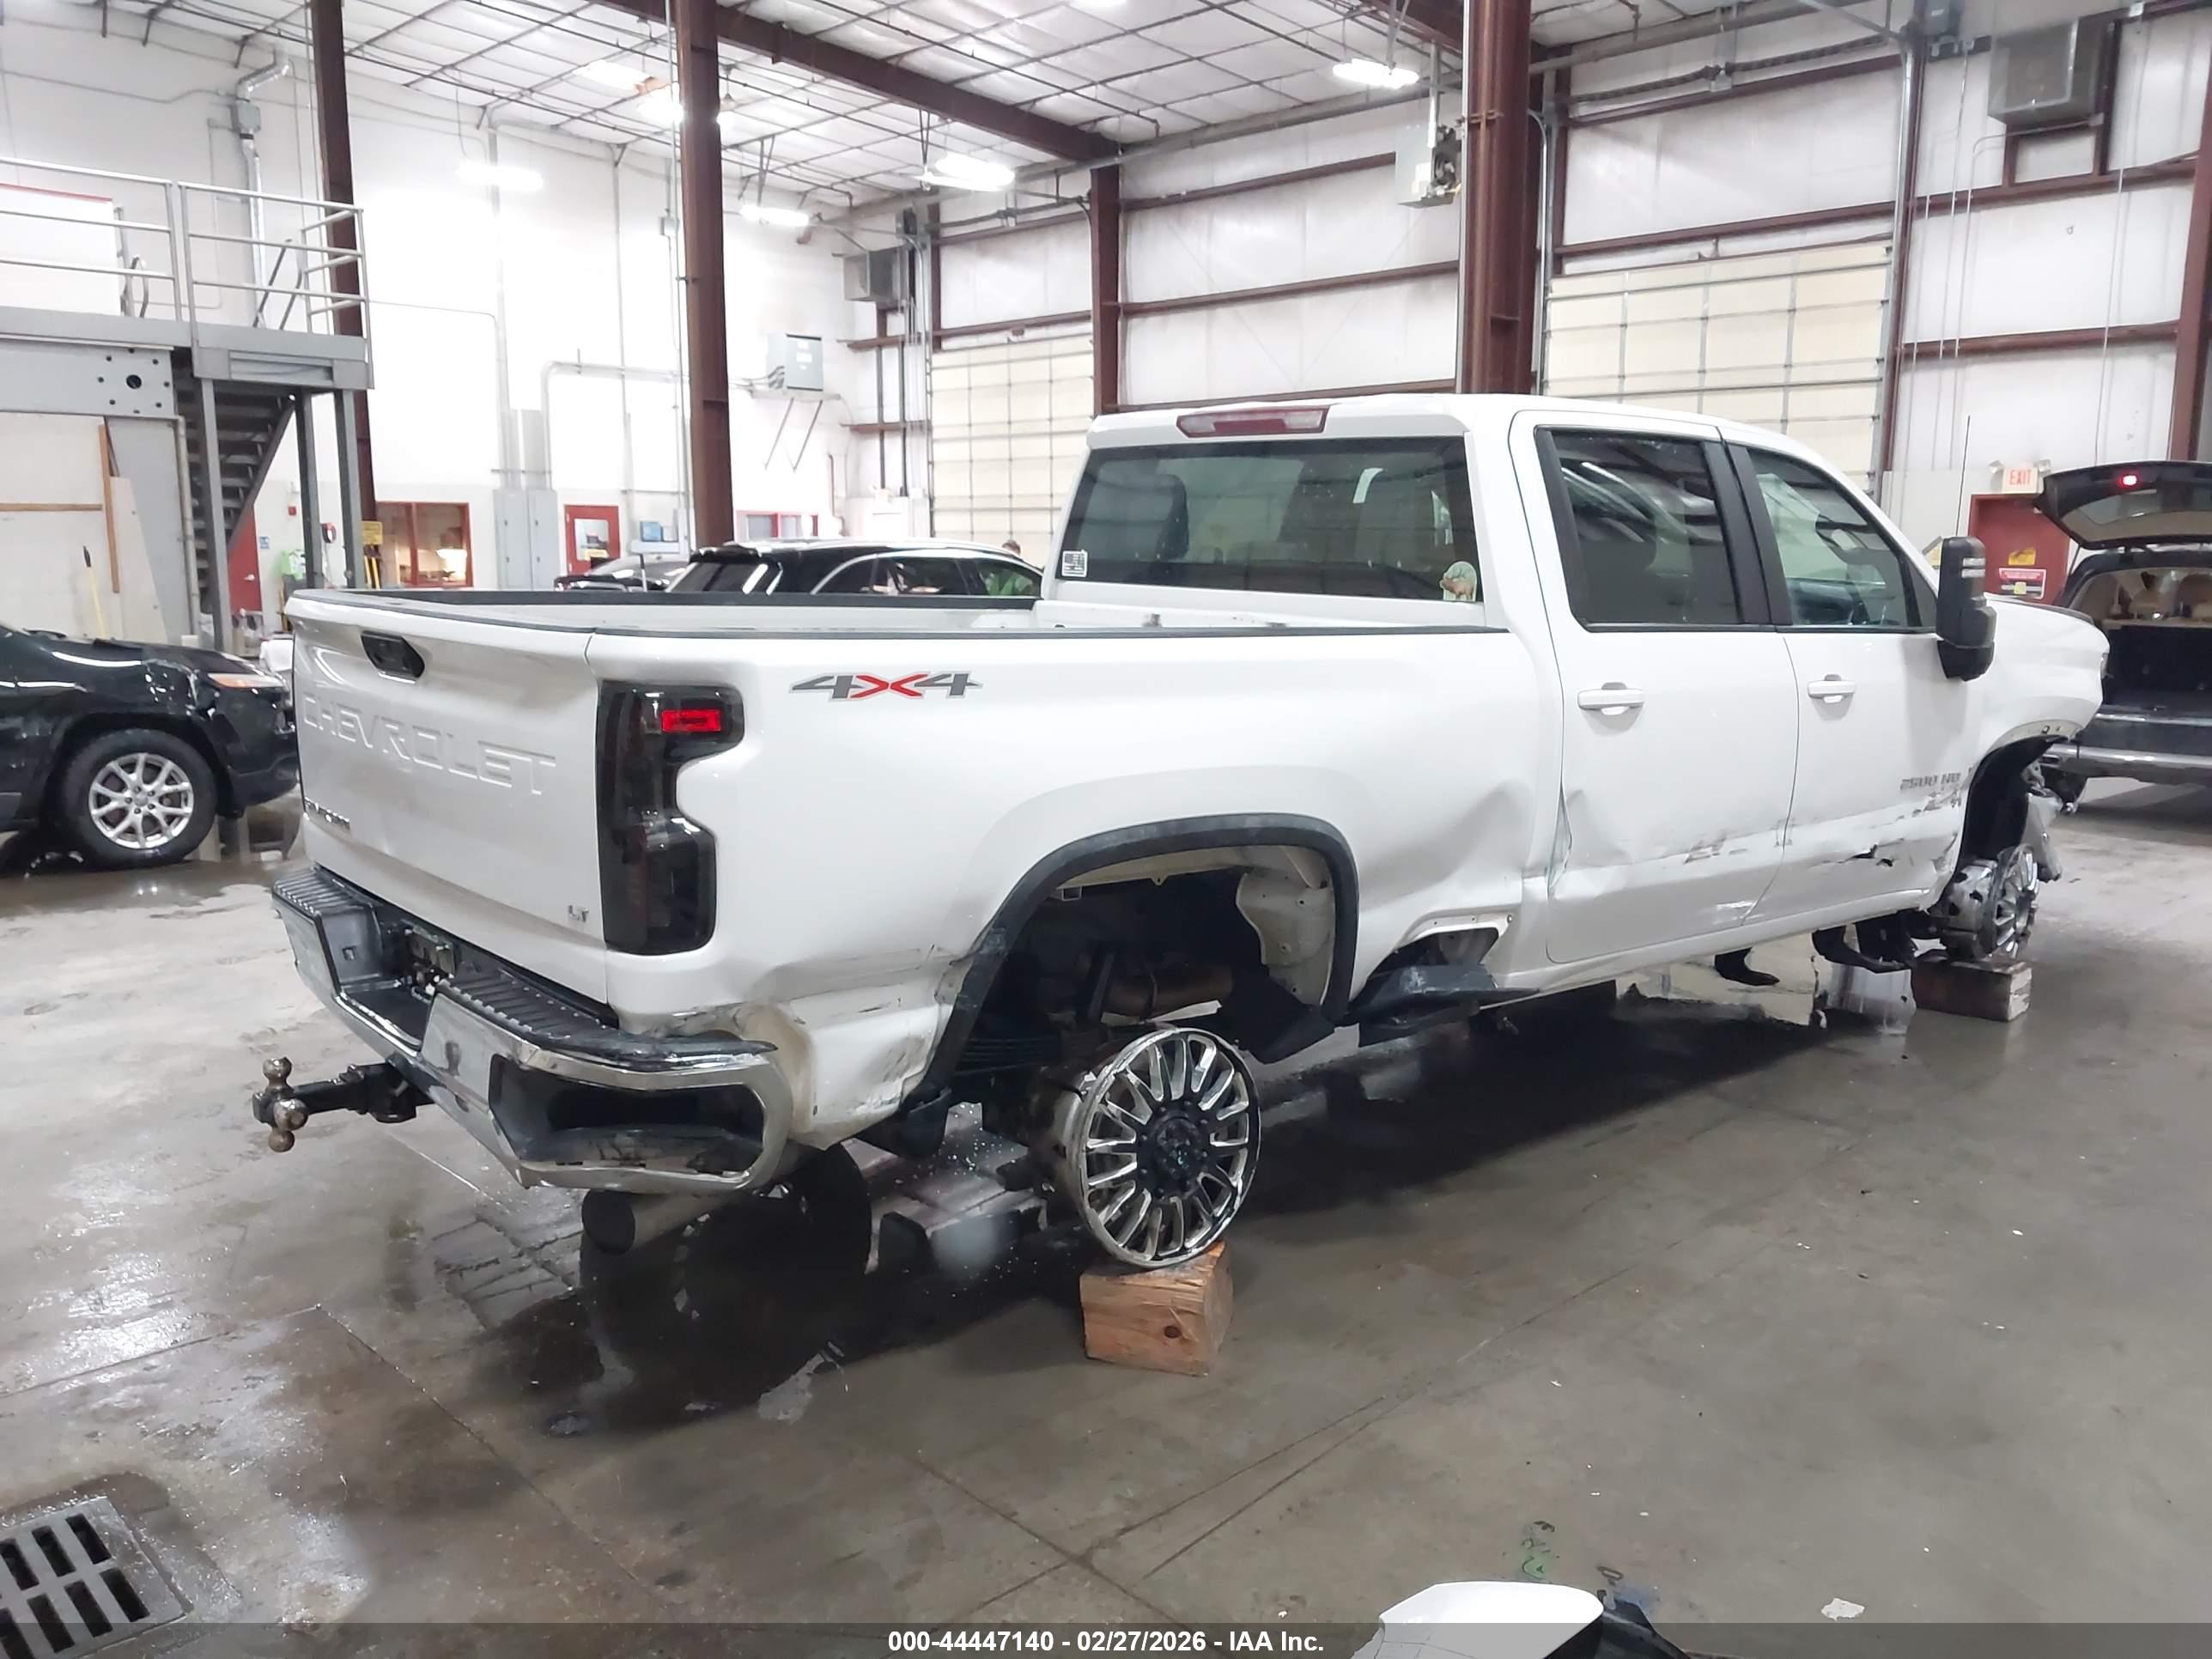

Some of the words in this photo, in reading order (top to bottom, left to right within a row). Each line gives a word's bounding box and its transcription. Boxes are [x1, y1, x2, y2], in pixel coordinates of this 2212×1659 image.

[2009, 470, 2032, 486] EXIT
[302, 690, 557, 797] CHEVROLET
[567, 904, 591, 924] LT
